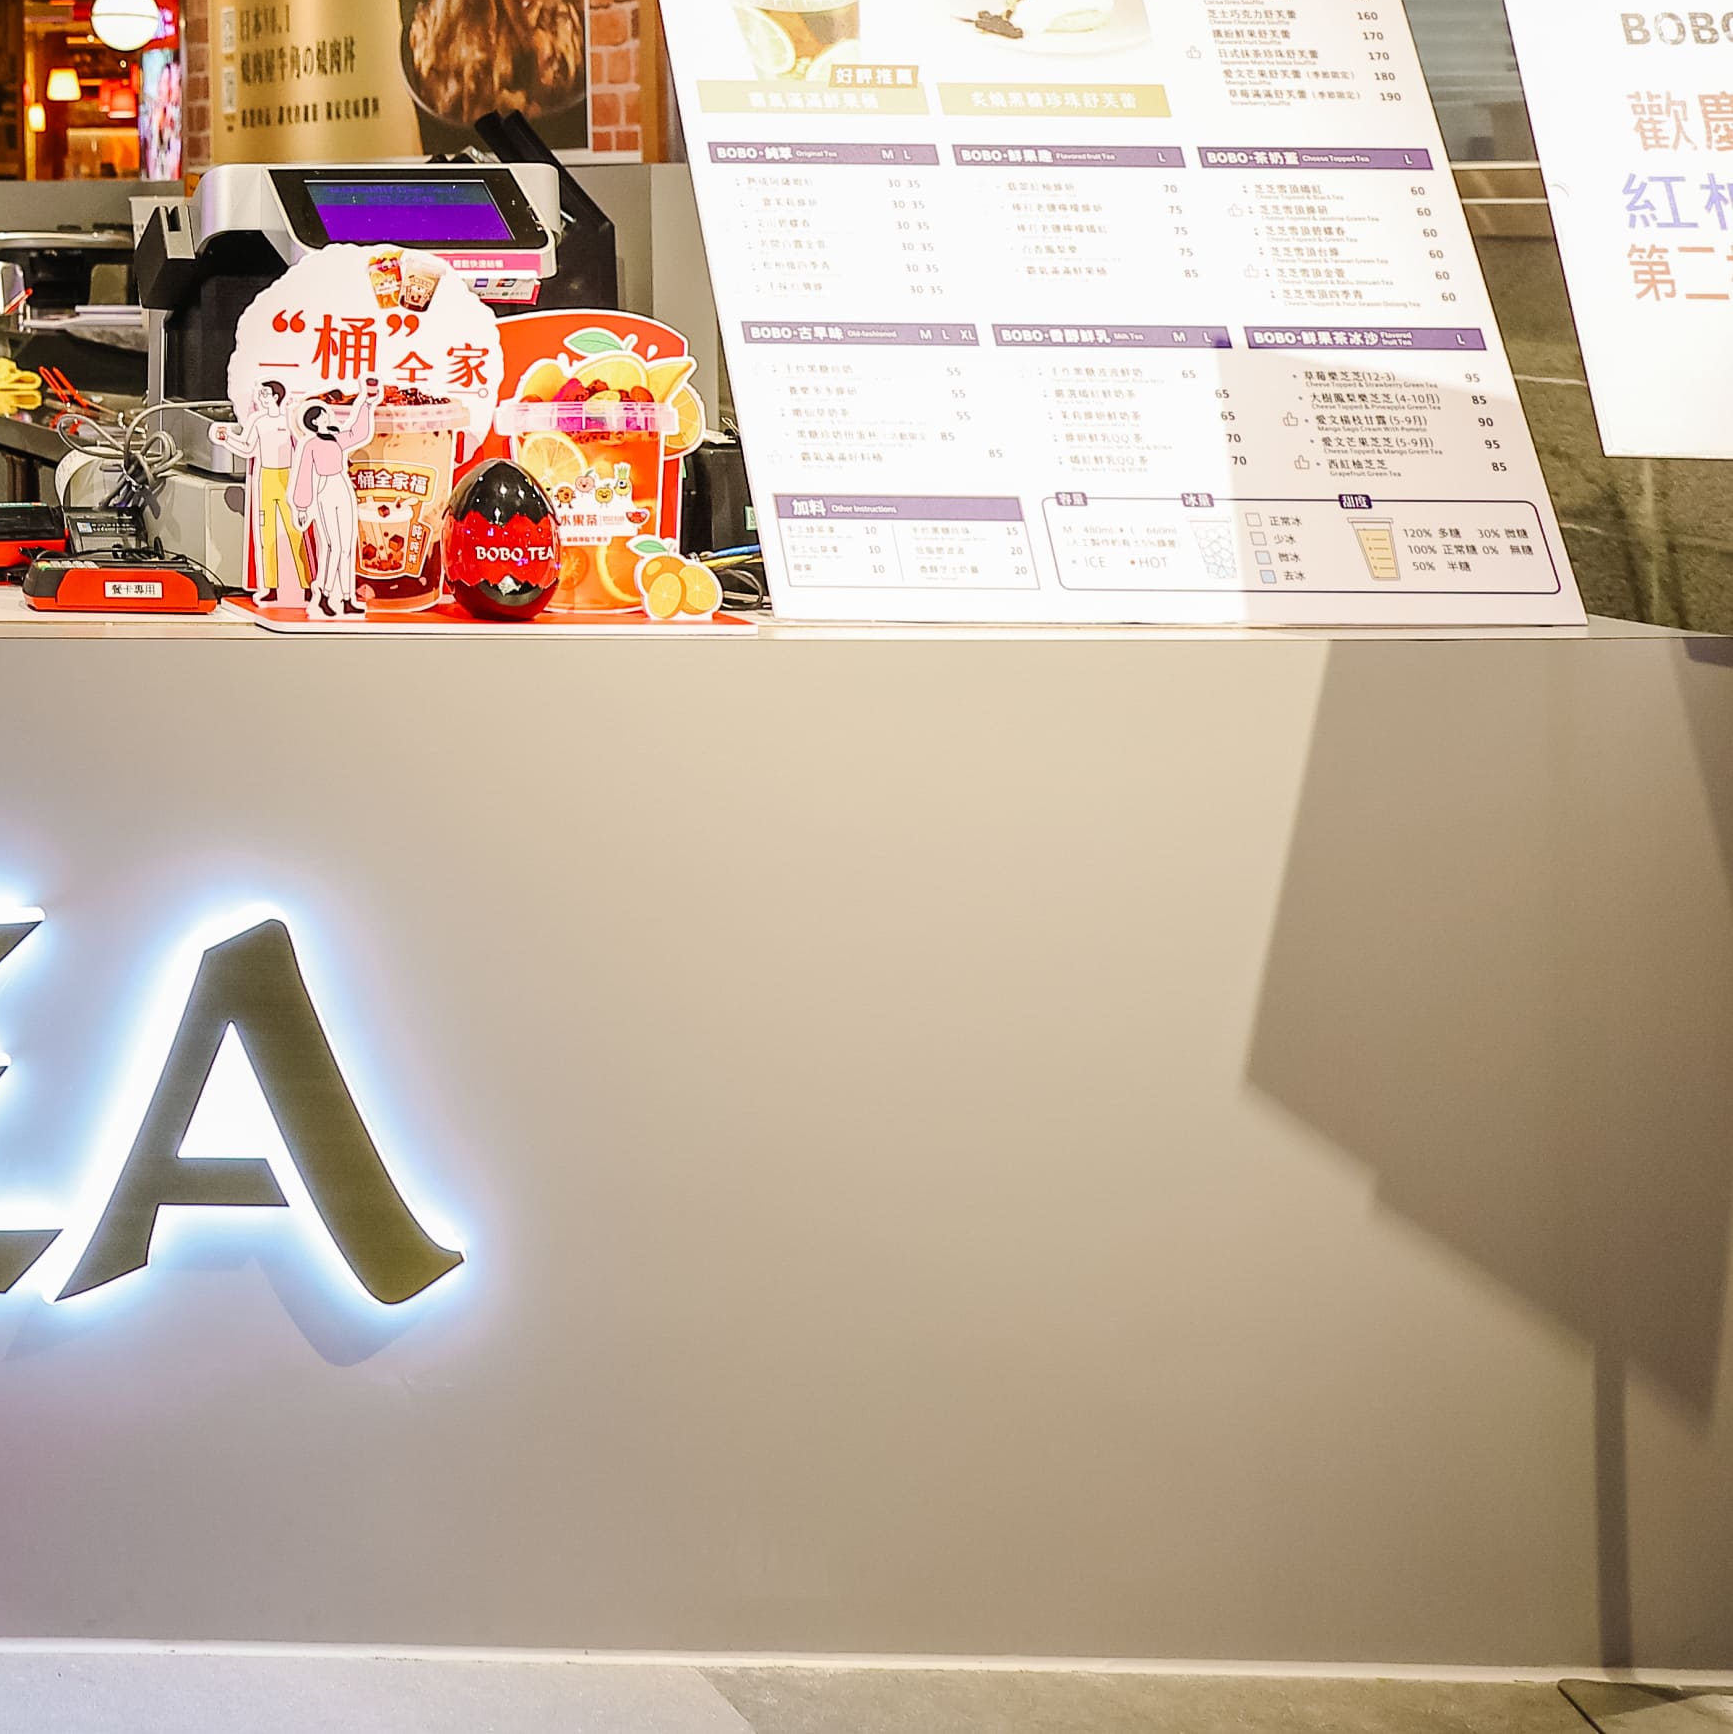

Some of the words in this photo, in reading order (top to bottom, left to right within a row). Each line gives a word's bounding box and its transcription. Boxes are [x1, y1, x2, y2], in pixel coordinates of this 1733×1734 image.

[1356, 11, 1380, 22] 160
[1362, 31, 1385, 41] 170
[1368, 51, 1391, 62] 170
[835, 67, 915, 87] 好評推薦
[1374, 71, 1397, 82] 180
[1379, 91, 1403, 103] 190
[880, 148, 895, 160] M
[902, 149, 912, 161] L
[1156, 152, 1166, 163] L
[1302, 155, 1329, 163] Cheese
[1329, 155, 1356, 165] Topped
[1356, 156, 1371, 164] Tea
[1403, 154, 1413, 165] L
[1410, 186, 1427, 197] 60
[1416, 207, 1433, 218] 60
[1422, 228, 1439, 239] 60
[1428, 249, 1445, 260] 60
[1435, 270, 1452, 281] 60
[1441, 292, 1458, 303] 60
[919, 329, 933, 341] M
[941, 329, 950, 341] L
[959, 329, 976, 342] XL
[1172, 331, 1186, 343] M
[1203, 331, 1212, 343] L
[1456, 334, 1465, 345] L
[1465, 373, 1480, 383] 95
[1471, 395, 1486, 405] 85
[1478, 416, 1493, 426] 90
[1485, 439, 1500, 449] 95
[1491, 462, 1506, 472] 85
[1058, 493, 1086, 506] 容量
[1185, 494, 1213, 507] 冰量
[792, 499, 826, 517] 加料
[831, 503, 851, 514] Other
[852, 503, 897, 514] Instructions
[1269, 515, 1303, 527] 正常冰
[1273, 534, 1297, 545] 少冰
[1403, 528, 1433, 539] 120%
[1437, 527, 1462, 540] 多糖
[1477, 528, 1502, 539] 30%
[1504, 528, 1530, 541] 微糖
[475, 546, 524, 562] BOBO
[526, 546, 554, 561] TEA
[1407, 544, 1438, 556] 100%
[1443, 543, 1478, 556] 正常糖
[1482, 545, 1500, 556] 0%
[1509, 544, 1534, 557] 無糖
[1278, 551, 1302, 563] 微冰
[1084, 556, 1106, 569] ICE
[1139, 556, 1169, 570] HOT
[1412, 560, 1436, 572] 50%
[1447, 560, 1472, 573] 半糖
[1283, 569, 1306, 581] 去冰
